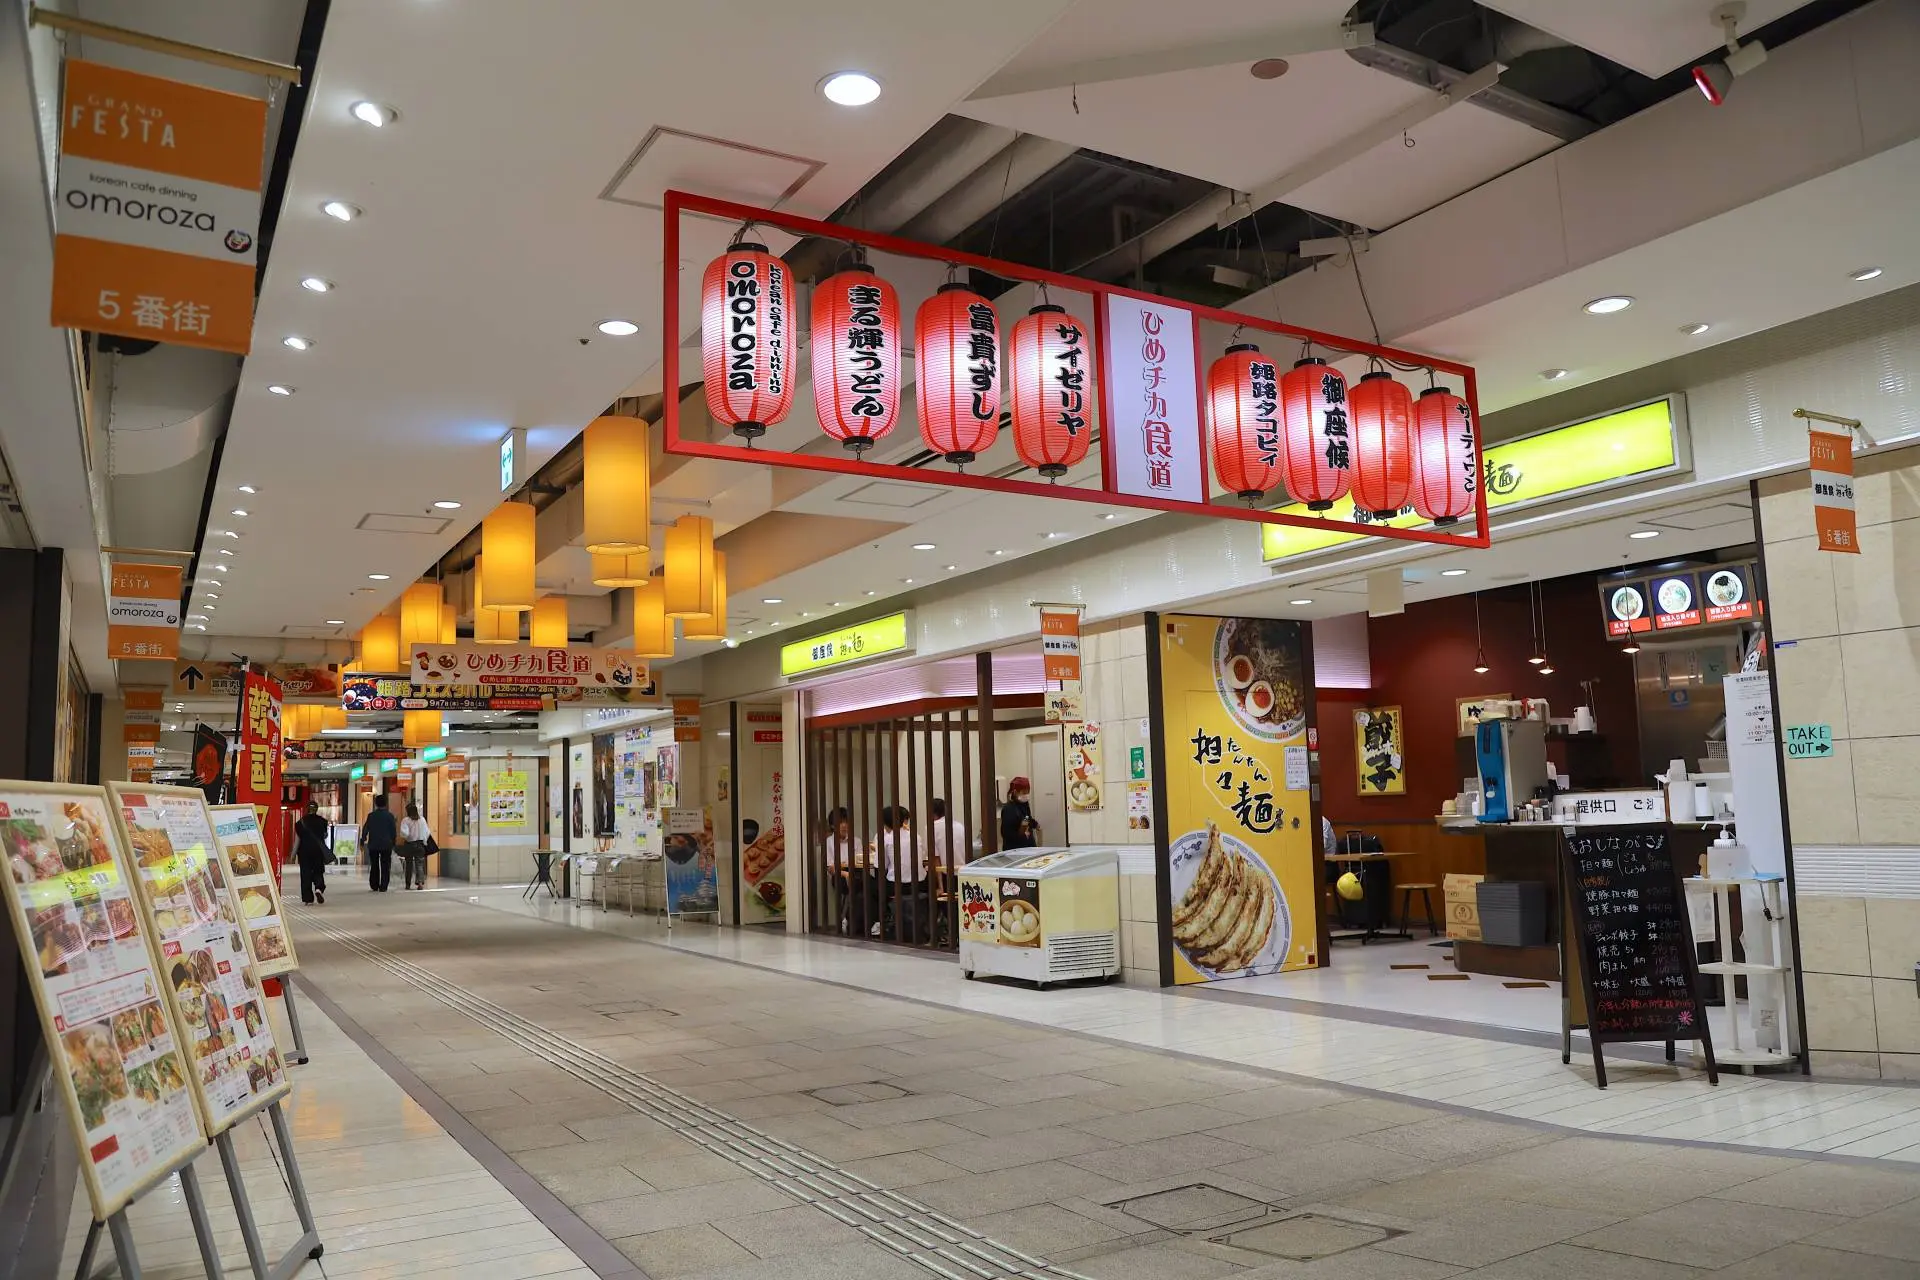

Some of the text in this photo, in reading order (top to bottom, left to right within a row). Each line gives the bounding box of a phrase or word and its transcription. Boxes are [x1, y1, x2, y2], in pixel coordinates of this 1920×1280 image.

[88, 94, 163, 118] GRAND
[71, 104, 176, 148] FESTA
[90, 172, 198, 201] korean cafe dinning
[66, 189, 215, 232] omoroza
[727, 261, 760, 390] omoroza
[769, 263, 782, 394] korean cafe dinning
[848, 285, 884, 416] まる輝うどん
[967, 303, 996, 420] 富貴ずし
[1055, 323, 1085, 436] サイゼリヤ
[1142, 310, 1172, 488] ひめチカ食道
[1250, 362, 1279, 467] 姫路タコピィ
[1322, 374, 1350, 469] 御座候
[1812, 446, 1836, 460] FESTA
[113, 577, 150, 589] FESTA
[111, 607, 164, 618] omoroza
[467, 650, 592, 675] ひめチカ食道
[1070, 732, 1096, 749] 肉まん
[1787, 726, 1827, 740] TAKE
[1788, 741, 1814, 755] OUT
[773, 771, 784, 836] 昔ながらの味
[1579, 836, 1656, 854] おしながき
[1580, 859, 1614, 873] 担々麺
[962, 881, 993, 903] 肉まん
